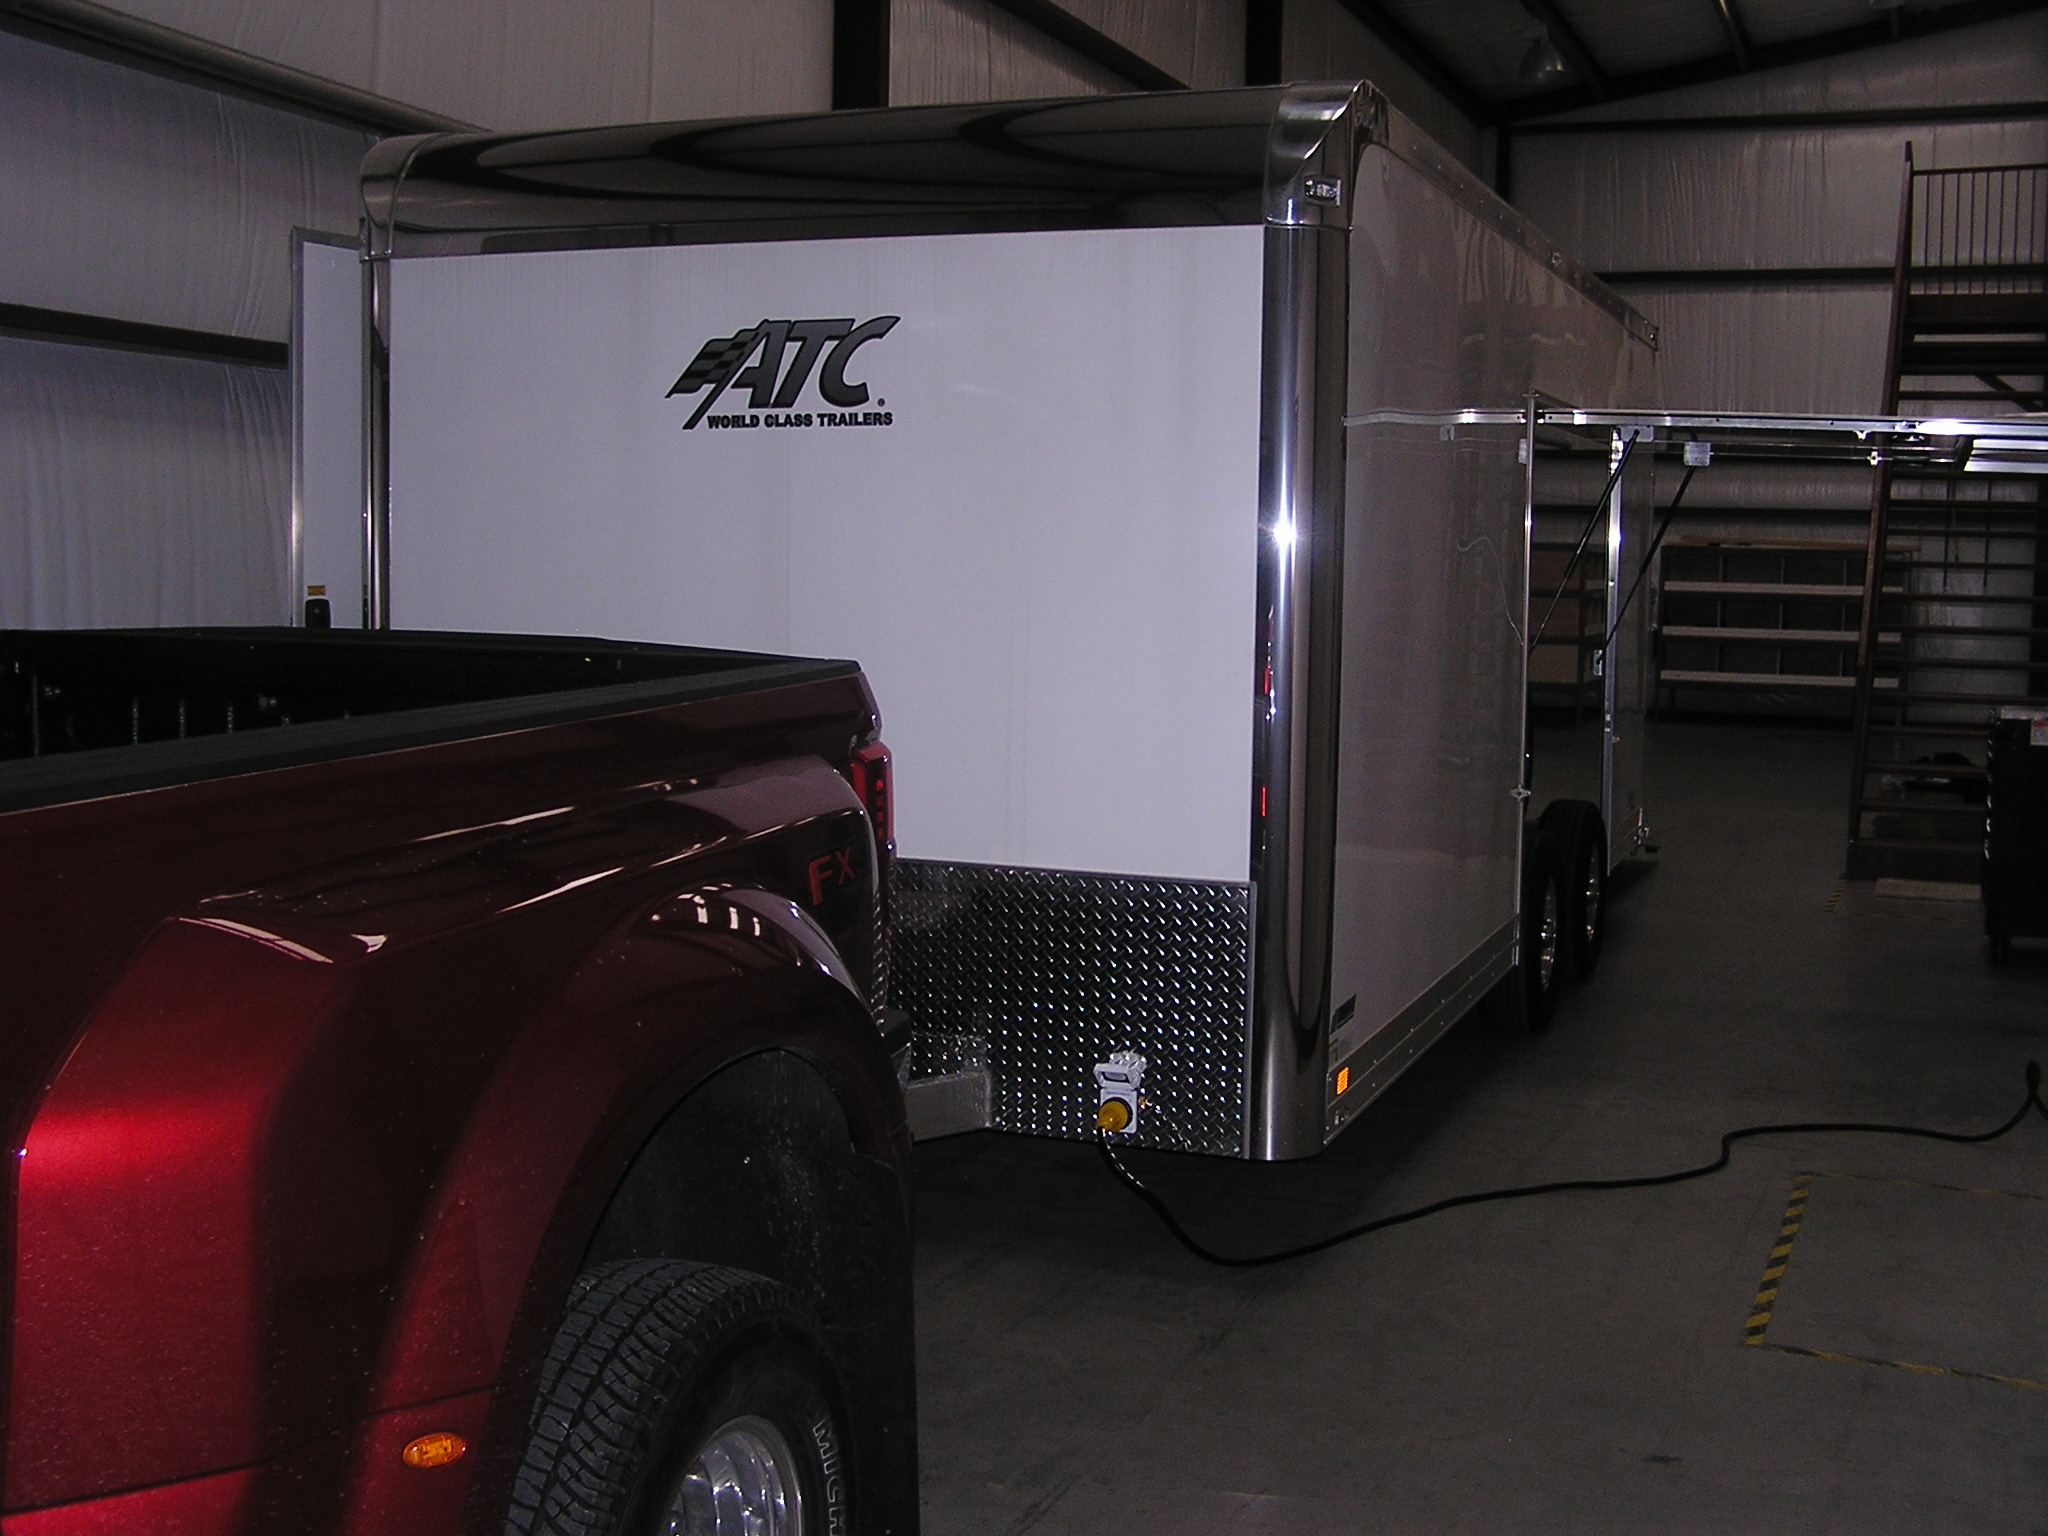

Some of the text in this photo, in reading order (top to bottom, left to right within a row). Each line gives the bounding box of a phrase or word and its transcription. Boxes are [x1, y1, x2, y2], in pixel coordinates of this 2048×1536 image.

[694, 315, 901, 409] ATC
[707, 412, 893, 429] WORLD CLASS TRAILERS
